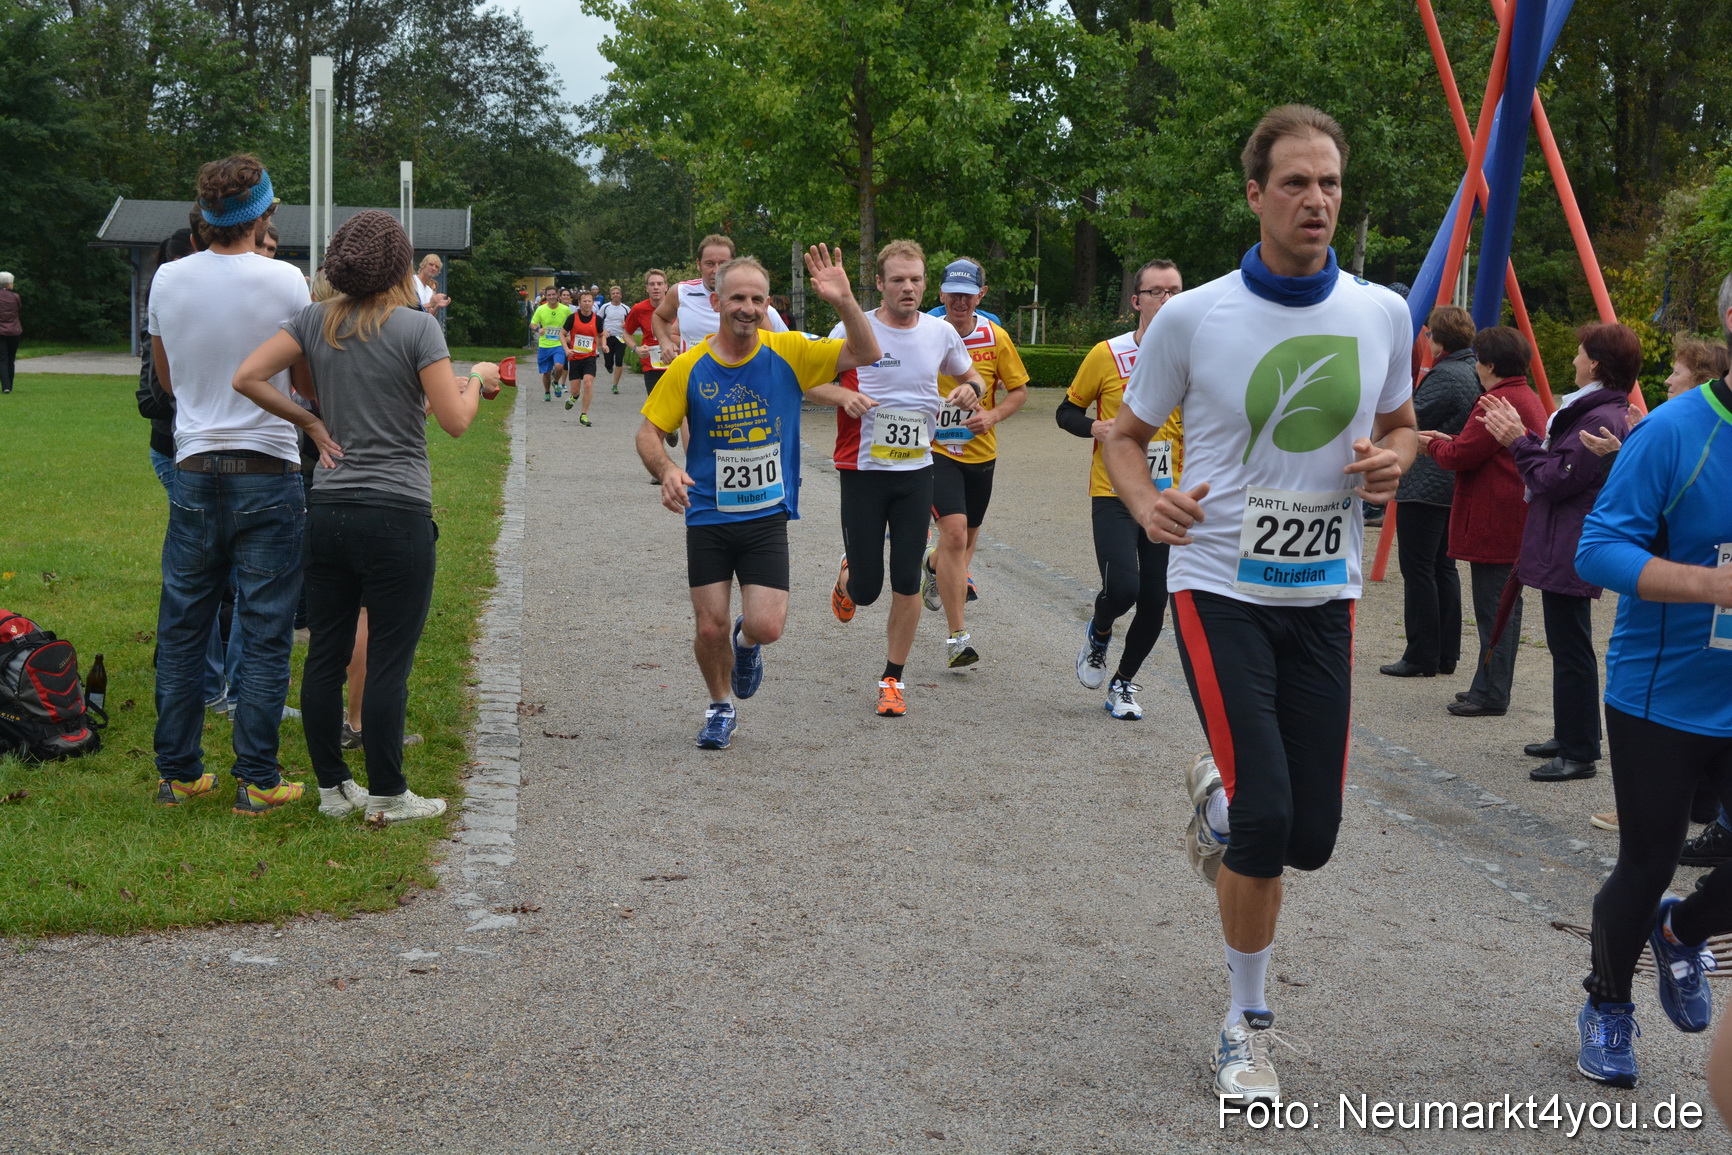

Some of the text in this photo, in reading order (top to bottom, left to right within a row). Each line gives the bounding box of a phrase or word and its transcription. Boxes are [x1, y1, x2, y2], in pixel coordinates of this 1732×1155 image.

[577, 338, 590, 348] 613
[970, 351, 997, 363] ÖGL
[876, 412, 898, 421] PARTL
[936, 409, 973, 427] 047
[717, 421, 753, 429] 21.September
[885, 423, 920, 447] 331
[935, 430, 964, 439] Andreas
[717, 453, 772, 463] PARTL Neumarkt
[889, 449, 912, 459] Frank
[203, 458, 247, 473] PMA
[1147, 454, 1168, 475] 74
[723, 460, 777, 489] 2310
[737, 491, 767, 503] Hubert
[1248, 496, 1340, 513] PARTL Neumarkt
[1252, 515, 1343, 558] 2226
[1263, 566, 1326, 584] Christian
